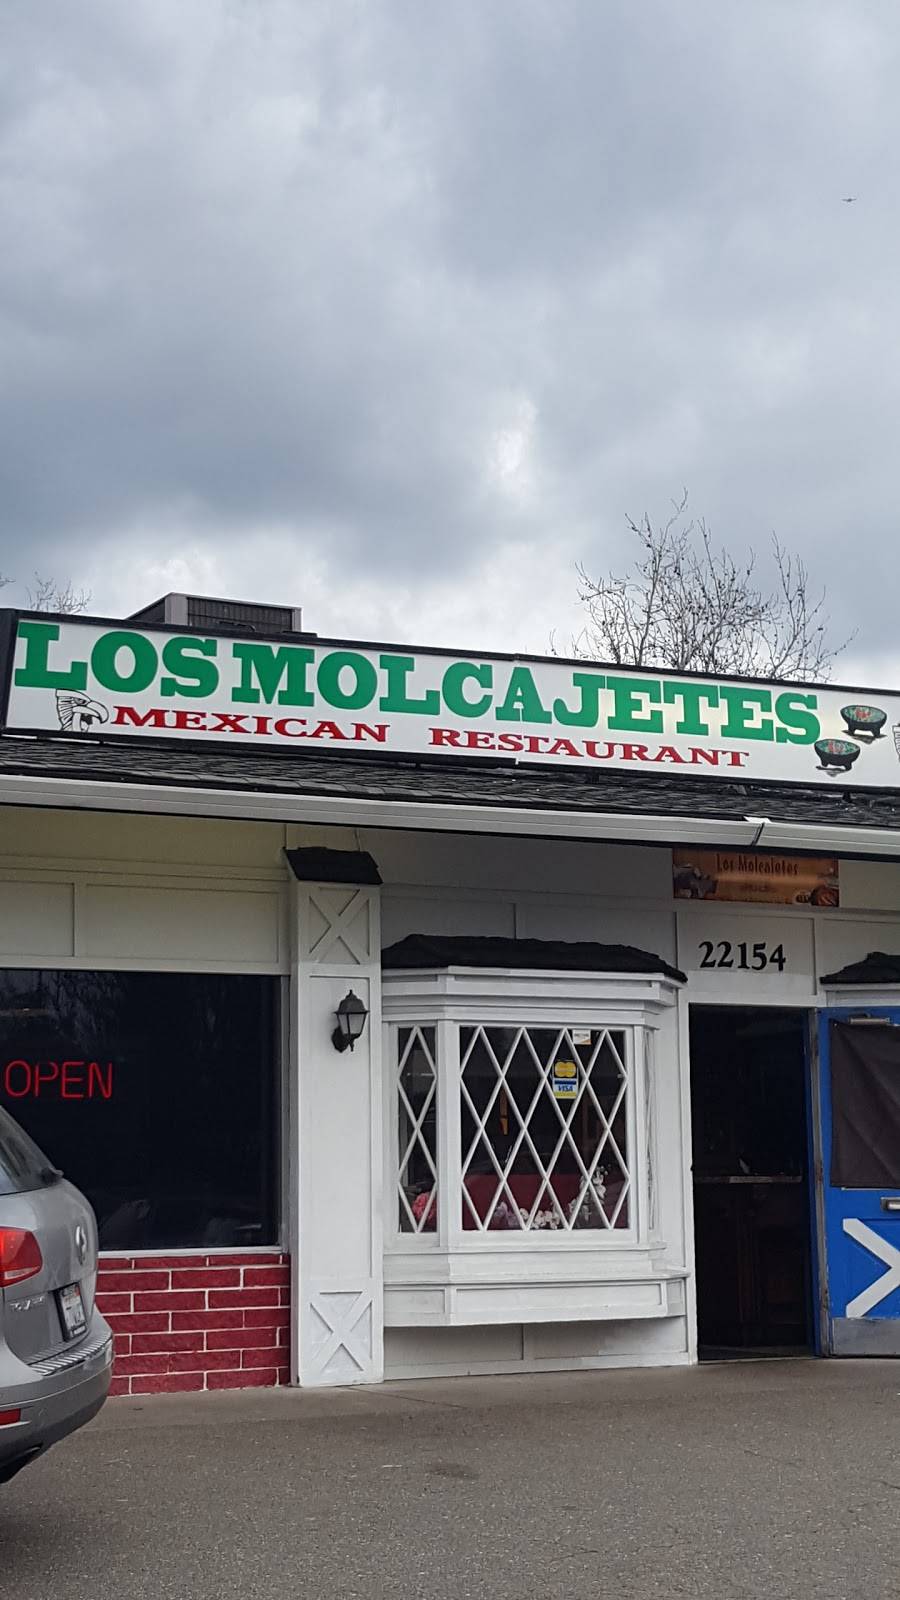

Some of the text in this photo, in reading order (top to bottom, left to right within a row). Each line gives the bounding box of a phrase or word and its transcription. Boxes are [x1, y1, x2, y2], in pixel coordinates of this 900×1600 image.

[15, 620, 822, 746] LOS MOLCAJETES
[113, 706, 750, 767] MEXICAN RESTAURANT
[716, 853, 734, 873] Los
[698, 941, 786, 972] 22154
[4, 1060, 113, 1099] OPEN
